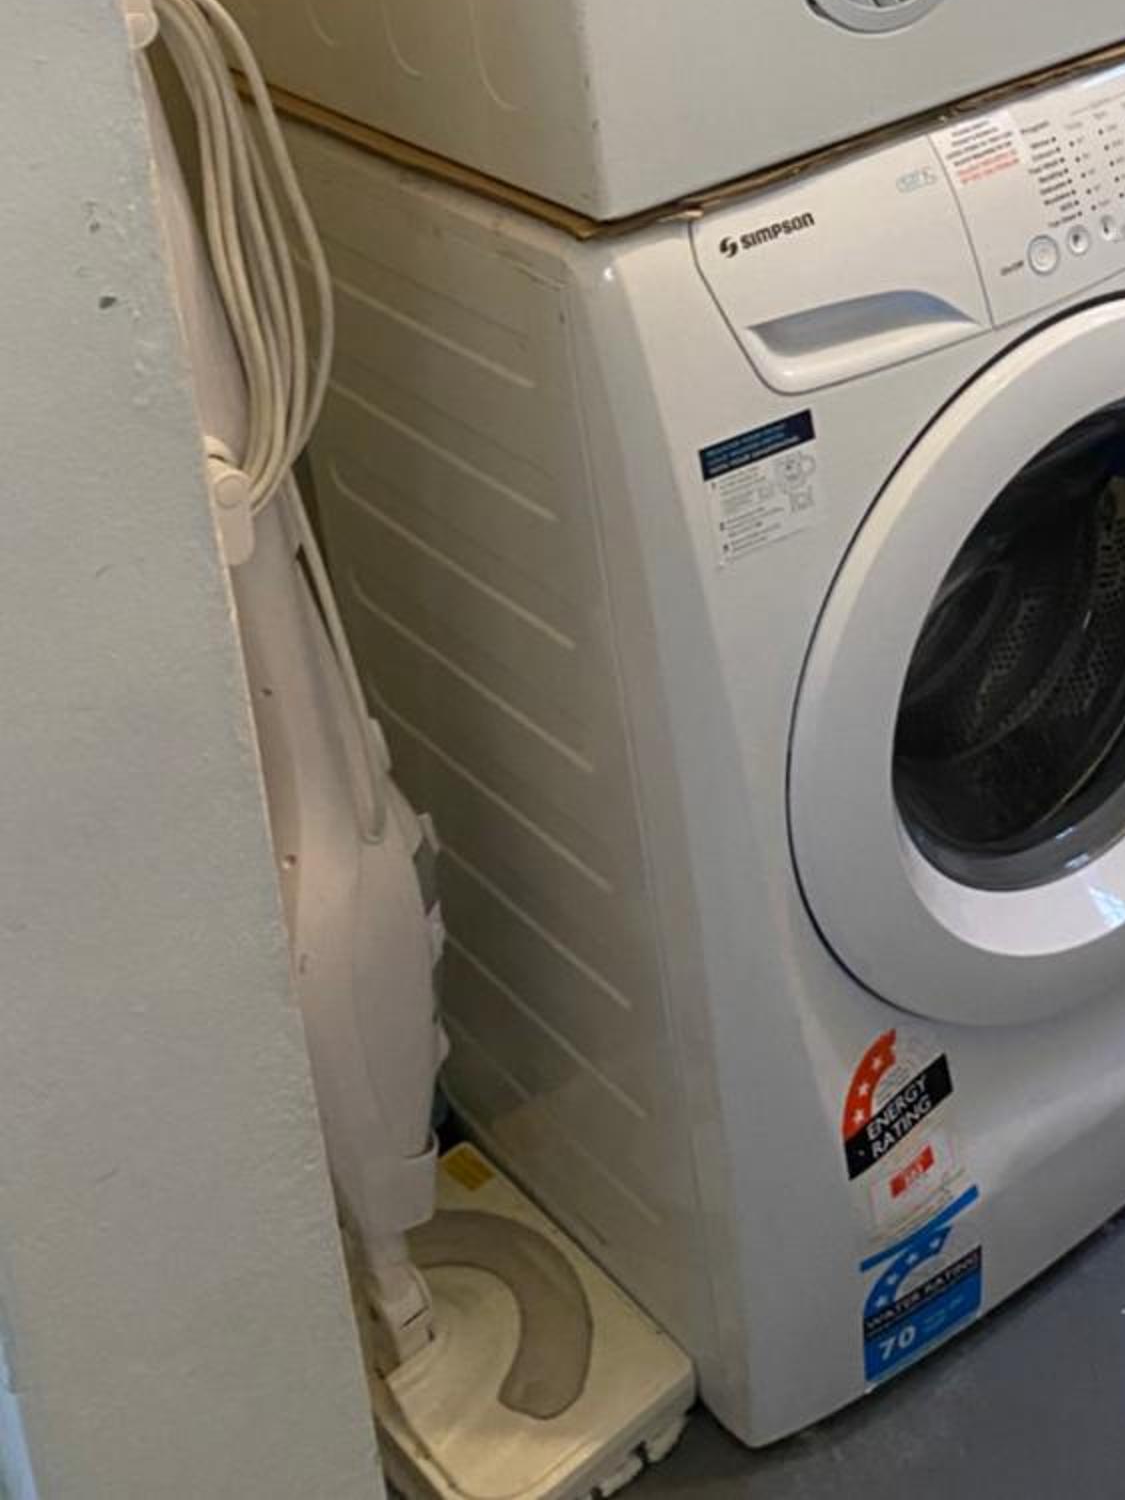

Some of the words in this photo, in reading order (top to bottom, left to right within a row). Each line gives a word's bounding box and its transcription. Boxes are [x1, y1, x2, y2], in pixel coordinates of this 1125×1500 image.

[866, 1074, 927, 1141] ENERGY
[872, 1094, 931, 1158] RATING
[879, 1325, 916, 1360] 70
